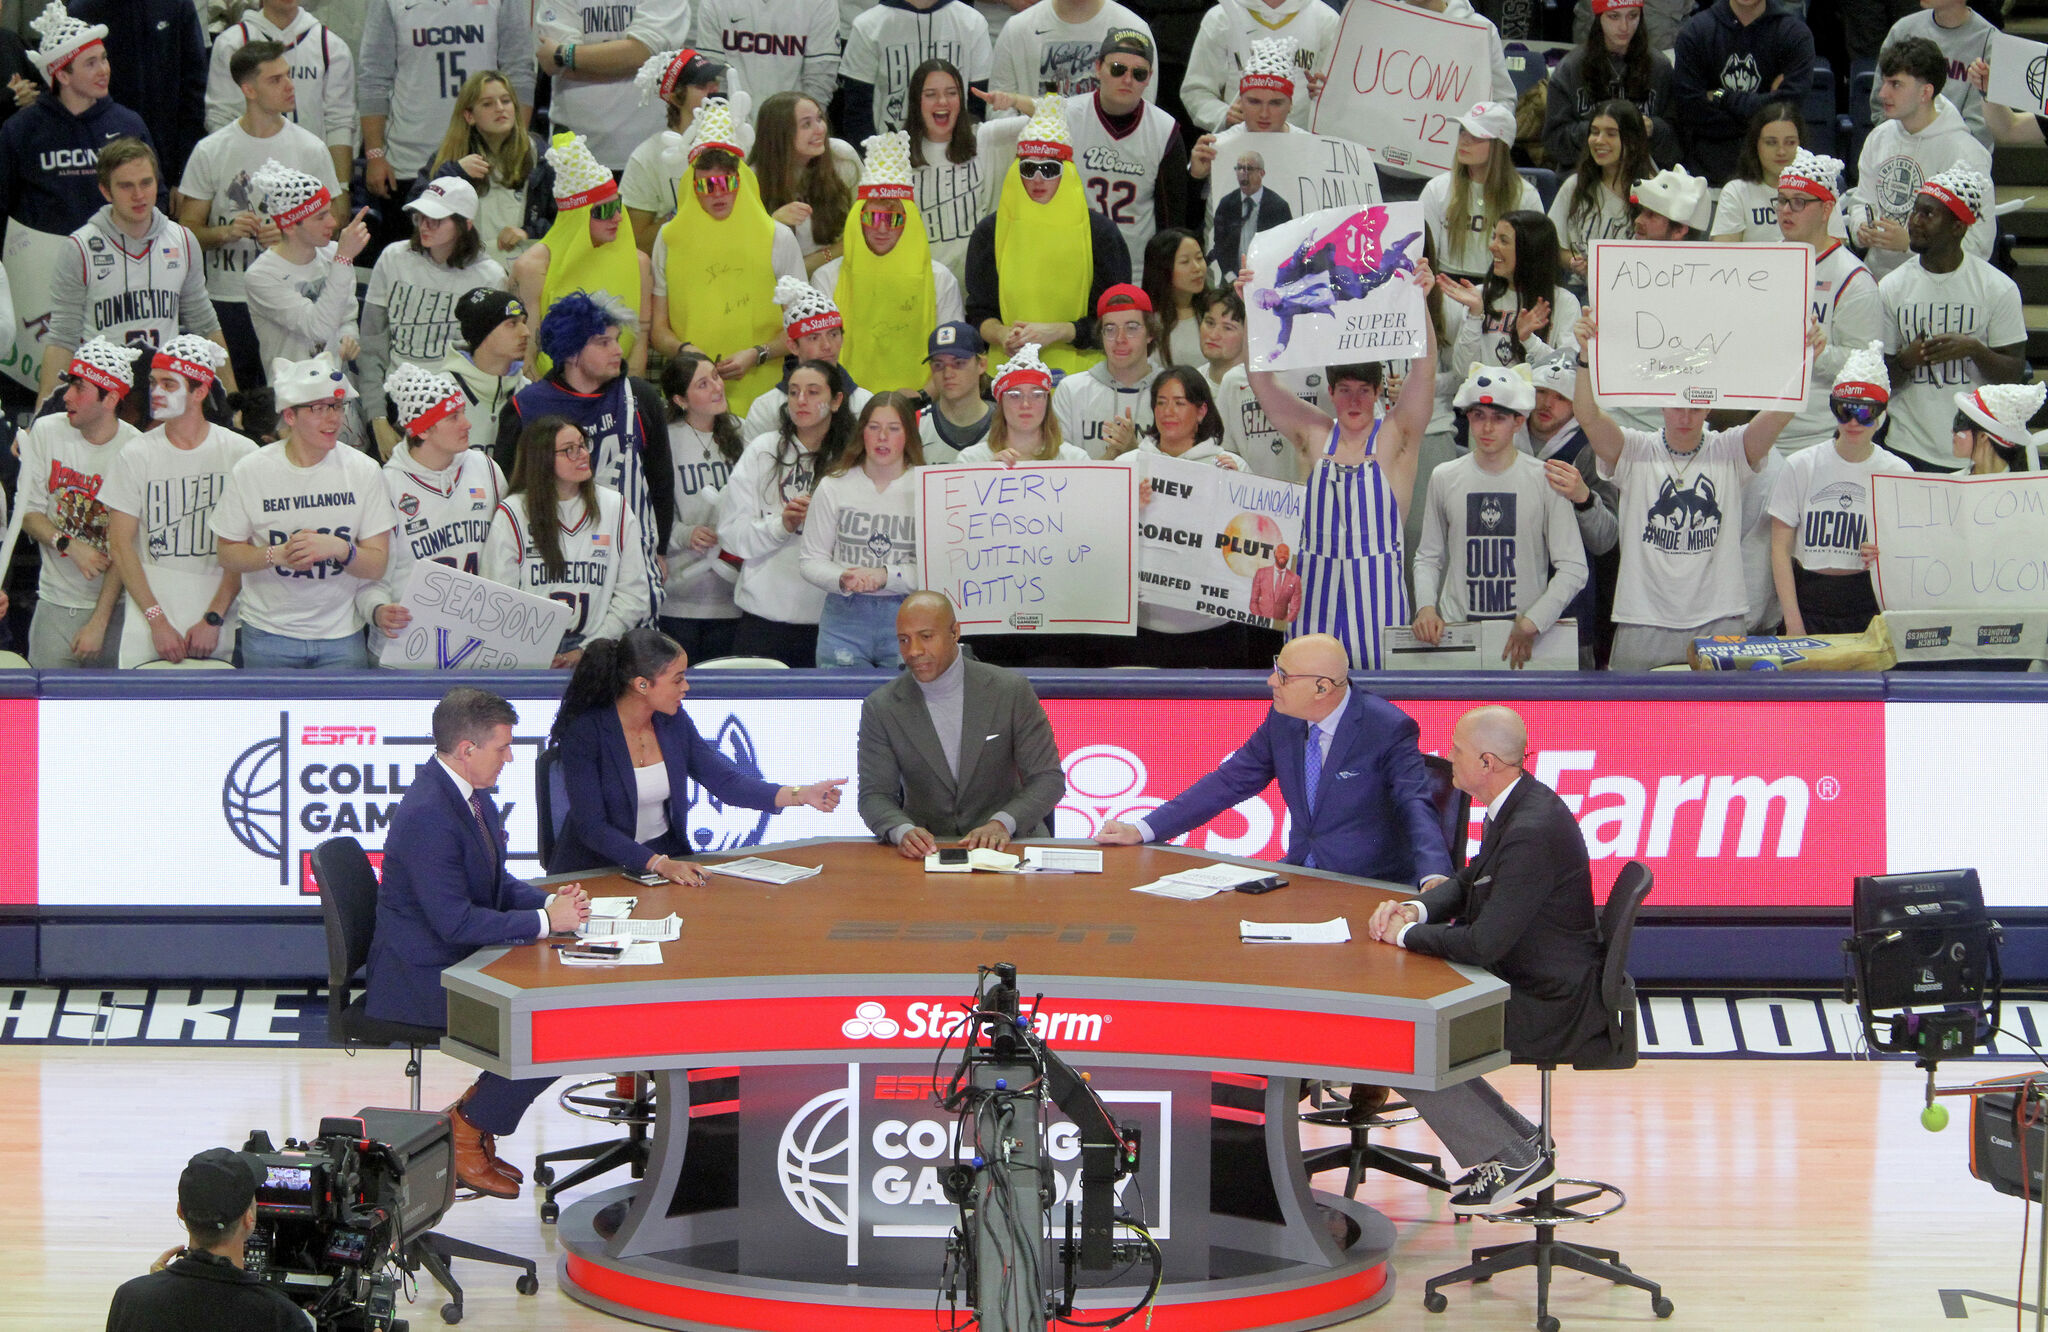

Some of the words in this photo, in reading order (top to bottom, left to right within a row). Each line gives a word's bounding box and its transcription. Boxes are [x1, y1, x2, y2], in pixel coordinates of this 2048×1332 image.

[412, 24, 485, 47] UCONN
[722, 29, 807, 56] UCONN
[436, 51, 467, 98] 15
[1353, 45, 1473, 102] UCONN
[1402, 113, 1449, 145] -12
[40, 148, 101, 171] UCON
[1083, 146, 1146, 176] UConn
[1320, 139, 1360, 176] IN
[913, 160, 984, 212] LEED
[1087, 175, 1138, 224] 32
[1298, 176, 1346, 216] DAN
[94, 289, 181, 331] CONNECTICU
[1345, 312, 1407, 332] SUPER
[1338, 330, 1419, 351] HURLEY
[677, 461, 735, 496] UCO
[944, 474, 1068, 510] EVERY
[1151, 477, 1194, 500] HEY
[263, 497, 291, 512] BEAT
[292, 491, 356, 510] VILLANOVA
[1894, 481, 1963, 529] LIV
[838, 508, 916, 542] UCON
[946, 511, 1064, 545] SEASON
[945, 544, 1053, 576] PUTTING
[1067, 544, 1092, 564] UP
[1466, 538, 1518, 579] OUR
[944, 574, 1046, 610] NATTYS
[1138, 570, 1192, 591] WARFED
[1200, 584, 1230, 599] THE
[1894, 555, 1952, 599] TO
[413, 571, 556, 645] SEASON
[1466, 579, 1518, 613] TIME
[1195, 600, 1272, 629] PROGRAM
[301, 725, 377, 746] ESPN
[826, 920, 1138, 944] ESPN
[0, 986, 366, 1042] ASKE
[904, 1002, 994, 1041] Sta
[872, 1119, 1083, 1162] COLG
